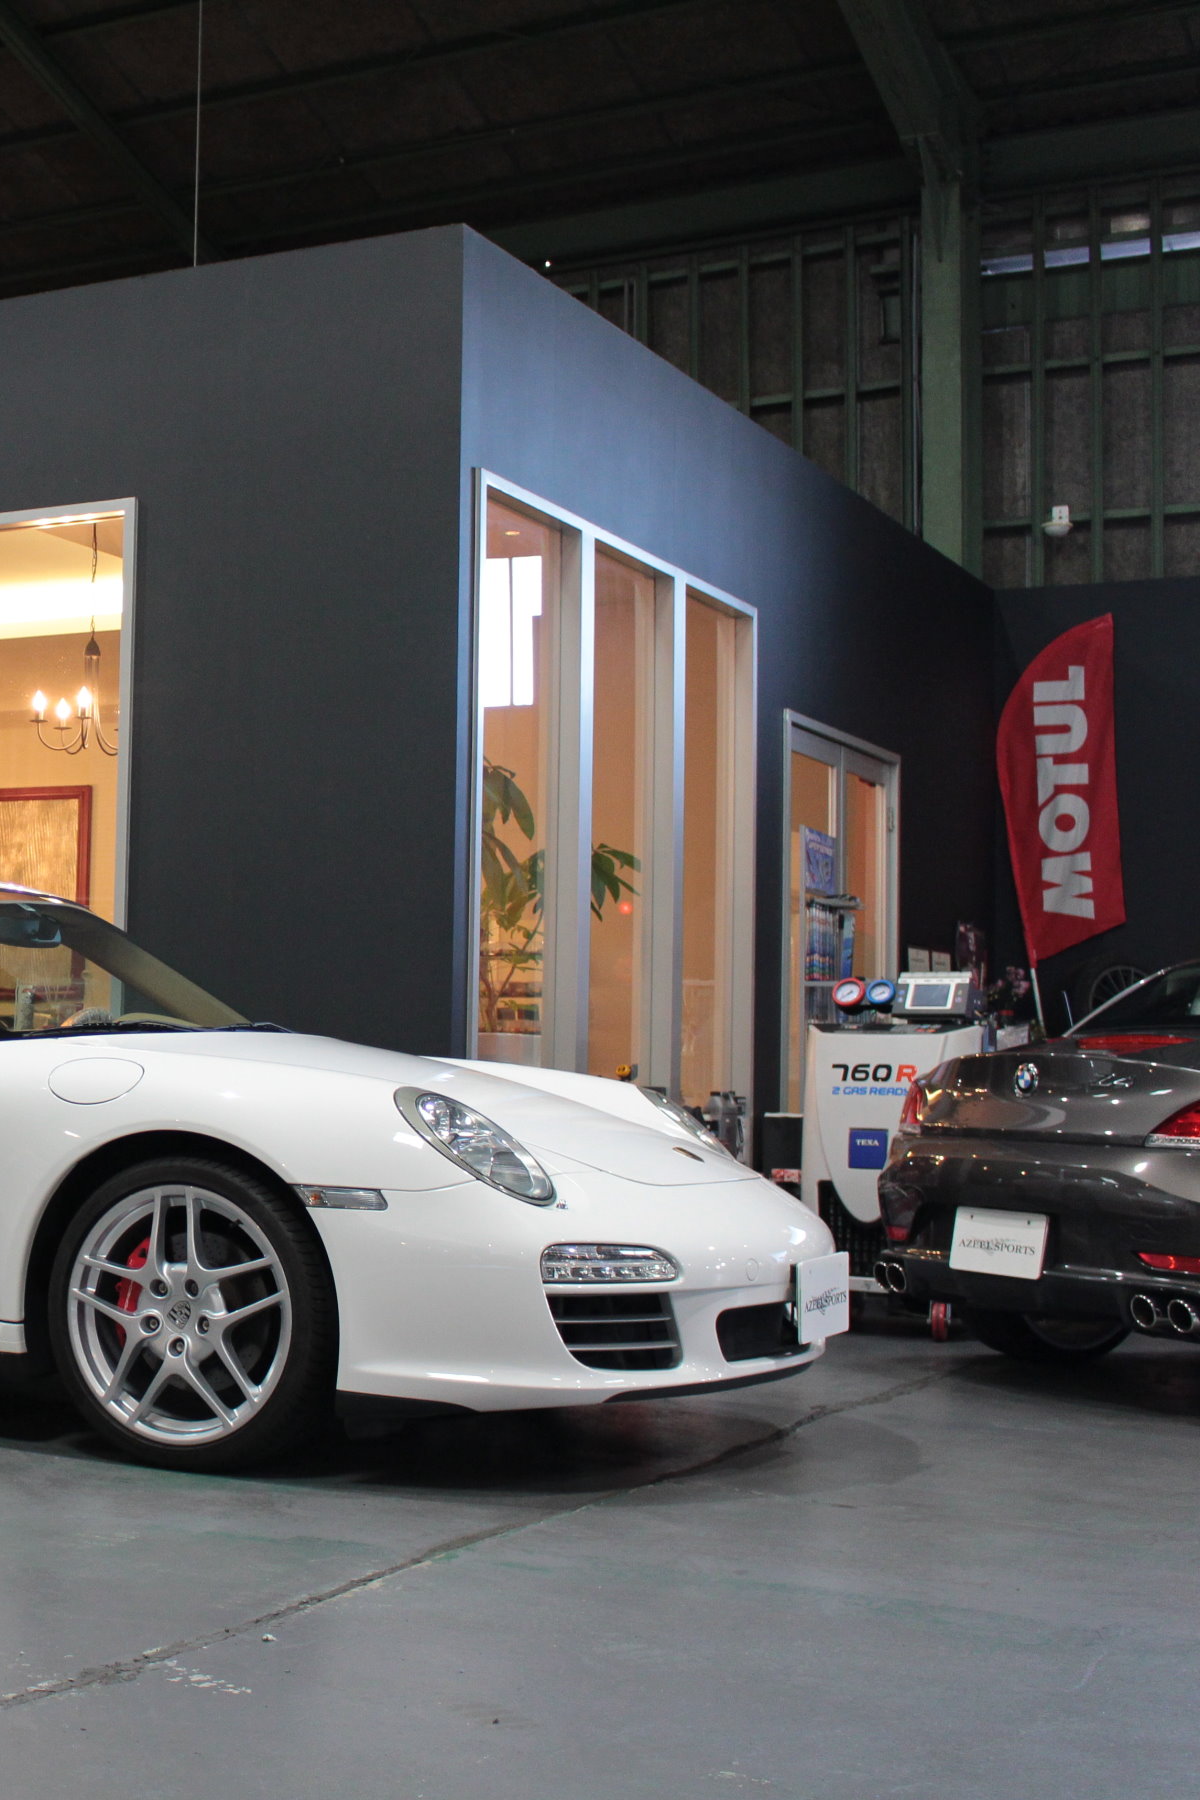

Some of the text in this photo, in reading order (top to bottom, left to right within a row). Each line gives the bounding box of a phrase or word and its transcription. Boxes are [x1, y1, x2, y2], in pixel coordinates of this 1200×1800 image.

[1033, 666, 1095, 919] MOTUL
[832, 1064, 917, 1082] 760 R
[832, 1086, 841, 1095] 2
[843, 1086, 867, 1095] GAS
[856, 1139, 880, 1147] TEXA
[994, 1241, 1036, 1256] SPORTS
